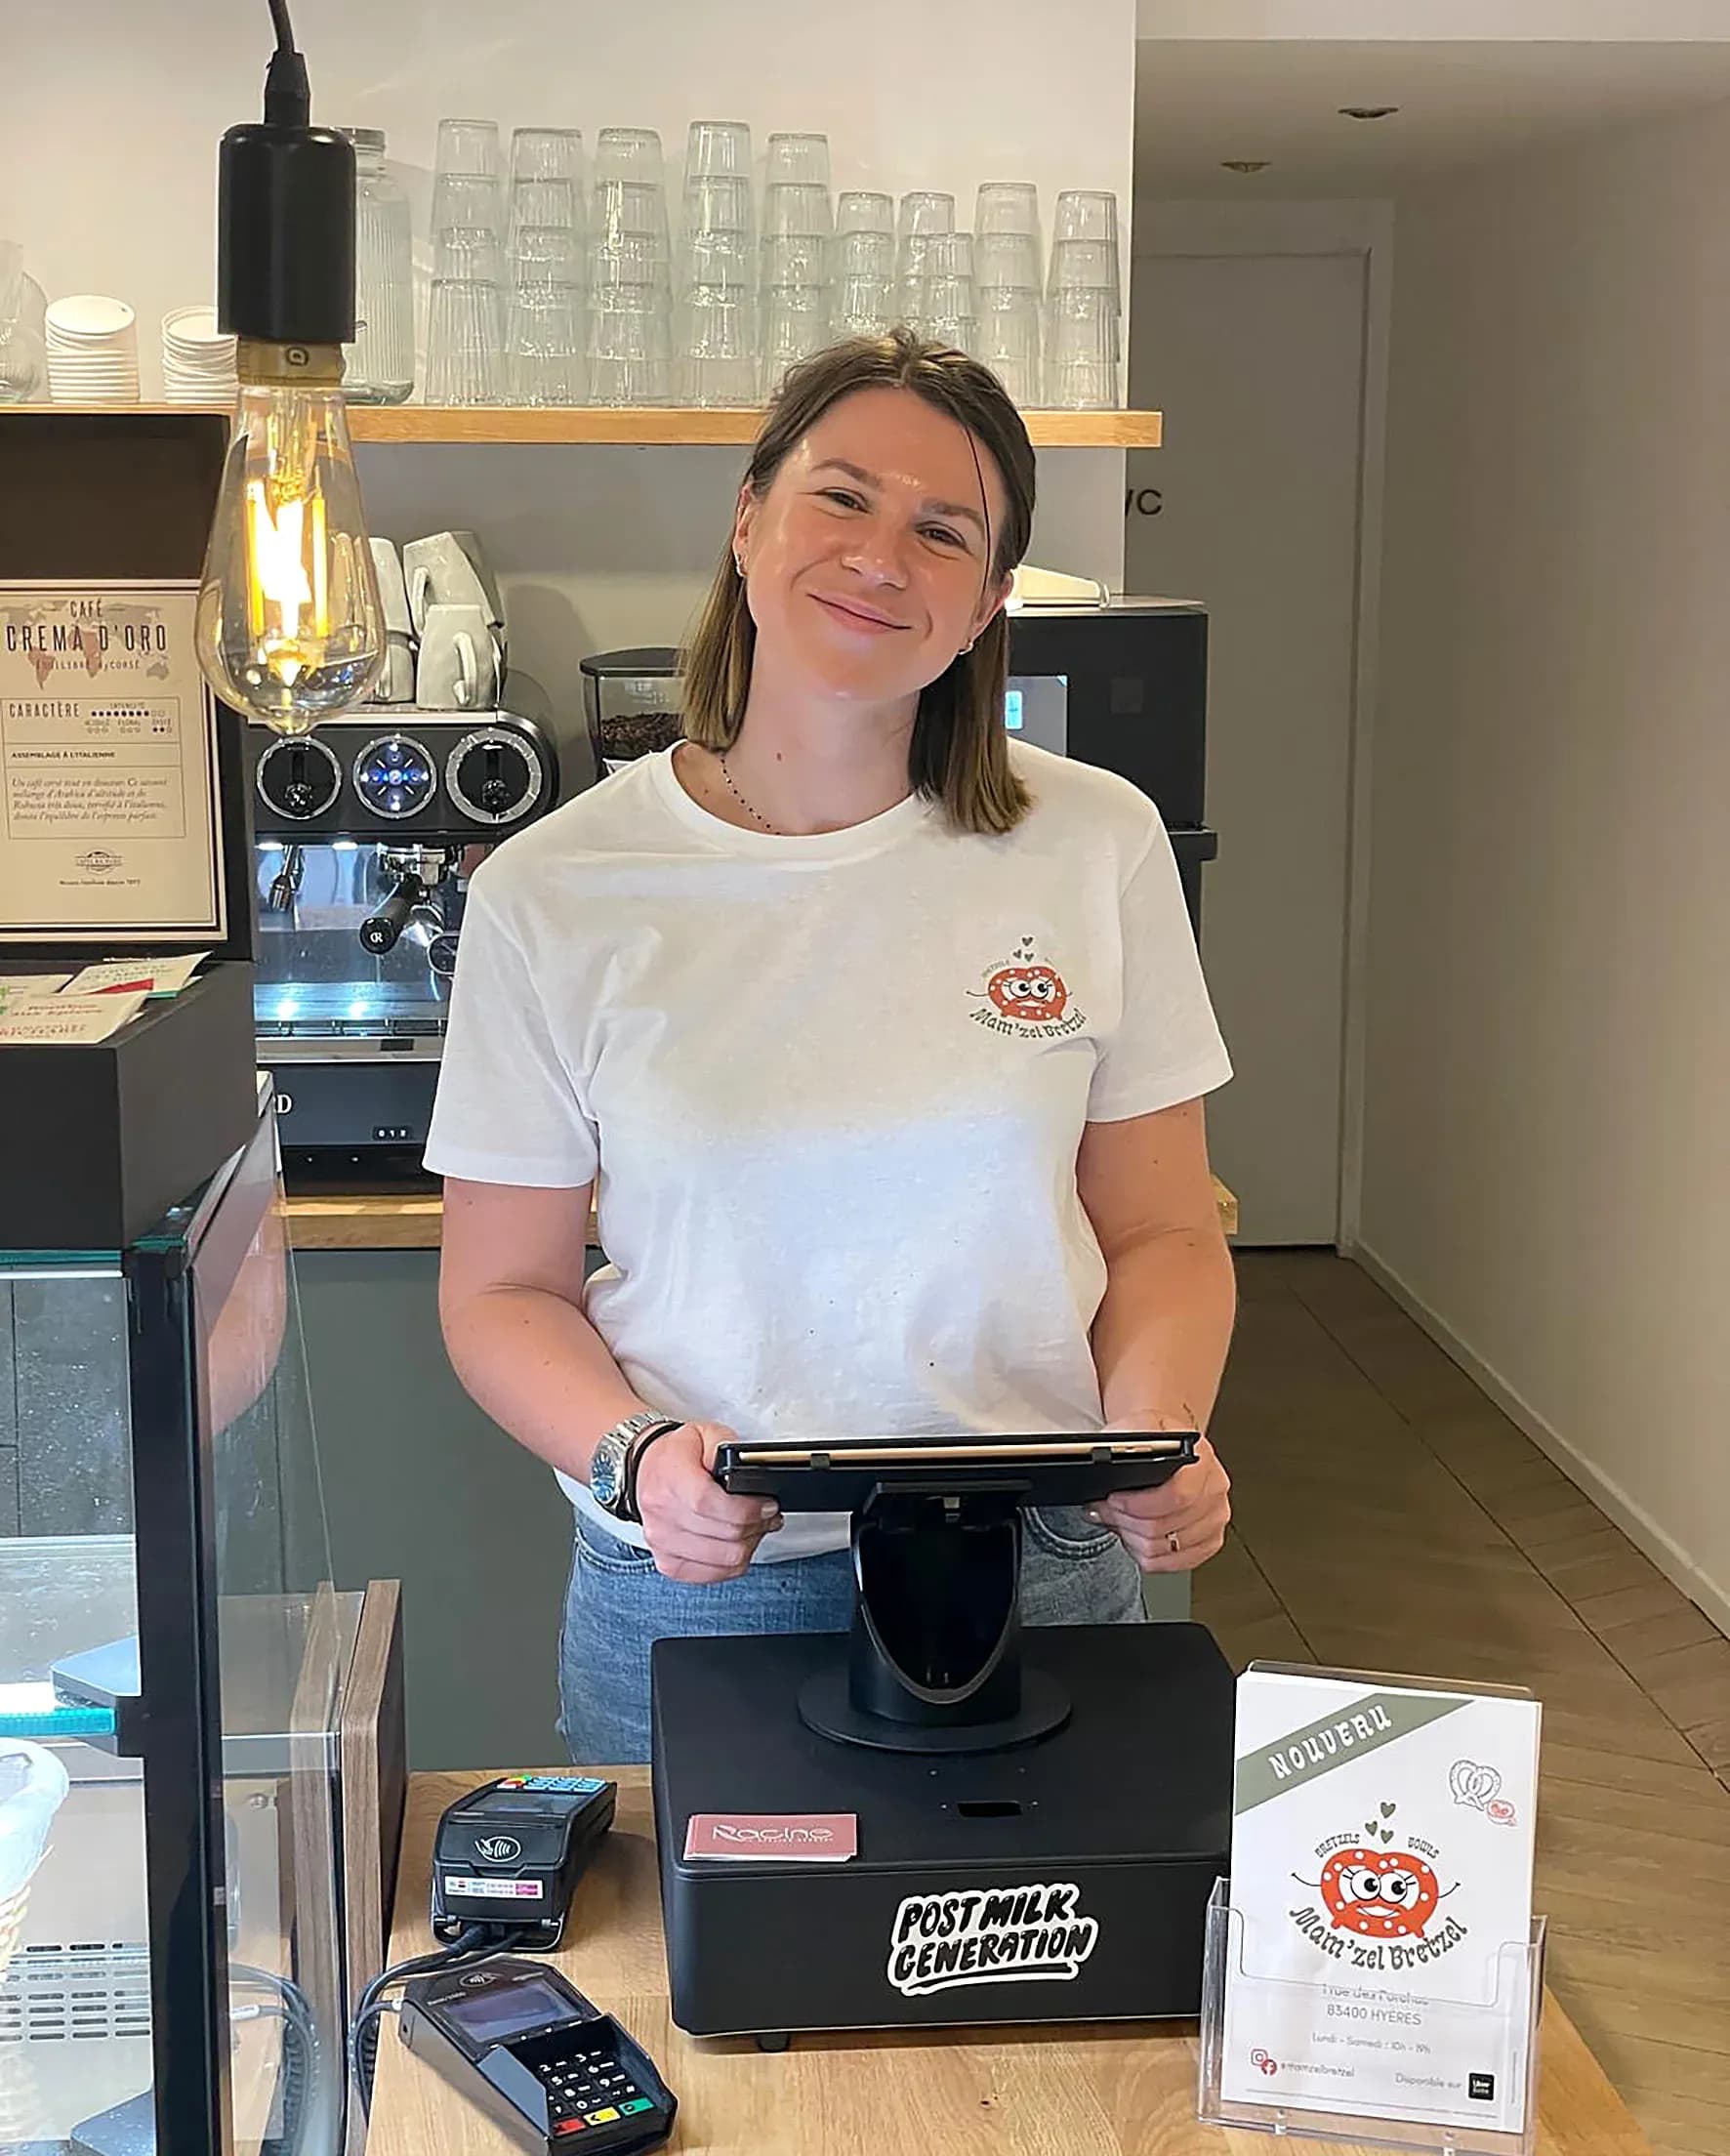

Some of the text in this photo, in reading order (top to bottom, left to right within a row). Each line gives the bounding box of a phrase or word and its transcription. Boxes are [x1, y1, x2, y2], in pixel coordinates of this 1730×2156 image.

[69, 598, 103, 618] CAFÉ
[7, 625, 167, 652] CREMA D'ORO
[9, 701, 80, 719] CARACTÈRE
[12, 751, 61, 760] ASSEMBLAGE
[969, 1008, 1044, 1038] Mam'zel
[1268, 1705, 1392, 1779] NOUVEAU
[713, 1824, 834, 1843] Racine
[1314, 1833, 1361, 1858] BRETZELS
[897, 1888, 1074, 1944] POST MILK
[1289, 1907, 1468, 1970] Mam'zel Bretzel
[893, 1923, 1093, 1982] GENERATION
[1327, 2003, 1368, 2019] 83400
